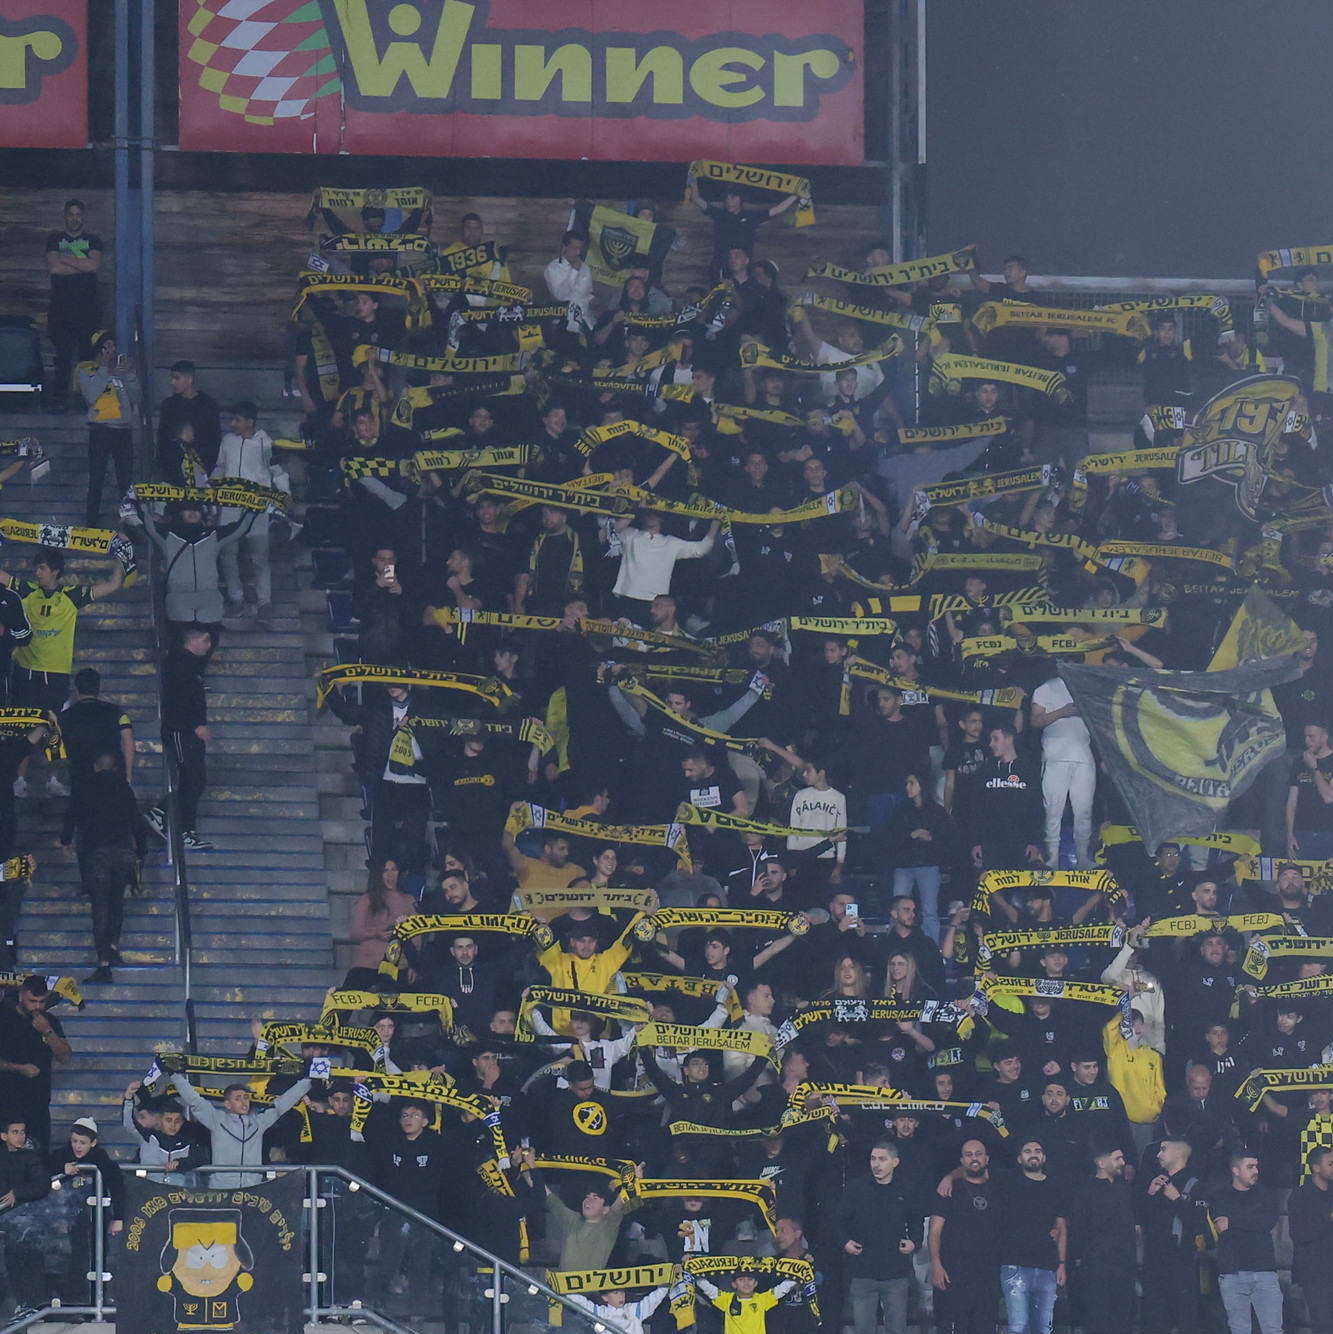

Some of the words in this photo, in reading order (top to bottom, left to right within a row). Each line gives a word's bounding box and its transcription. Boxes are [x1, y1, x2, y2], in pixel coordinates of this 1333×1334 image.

[334, 0, 840, 107] Winner
[709, 162, 792, 188] ירושלים
[449, 246, 489, 270] 1936
[415, 356, 498, 371] ירושלים
[135, 484, 184, 499] ירושלים
[1051, 638, 1077, 650] FCBJ
[985, 779, 1027, 790] ellesse
[1169, 920, 1197, 931] FCBJ
[1242, 914, 1269, 926] FCBJ
[987, 932, 1036, 948] ירושלים
[1054, 927, 1110, 941] JERUSALEM
[334, 993, 362, 1006] FCBJ
[416, 994, 445, 1006] FCBJ
[870, 1010, 921, 1021] JERUSALEM
[656, 1034, 692, 1046] BEITAR
[694, 1036, 751, 1050] JERUSALEM
[127, 1216, 147, 1252] 2005
[566, 1268, 664, 1290] ירושלים
